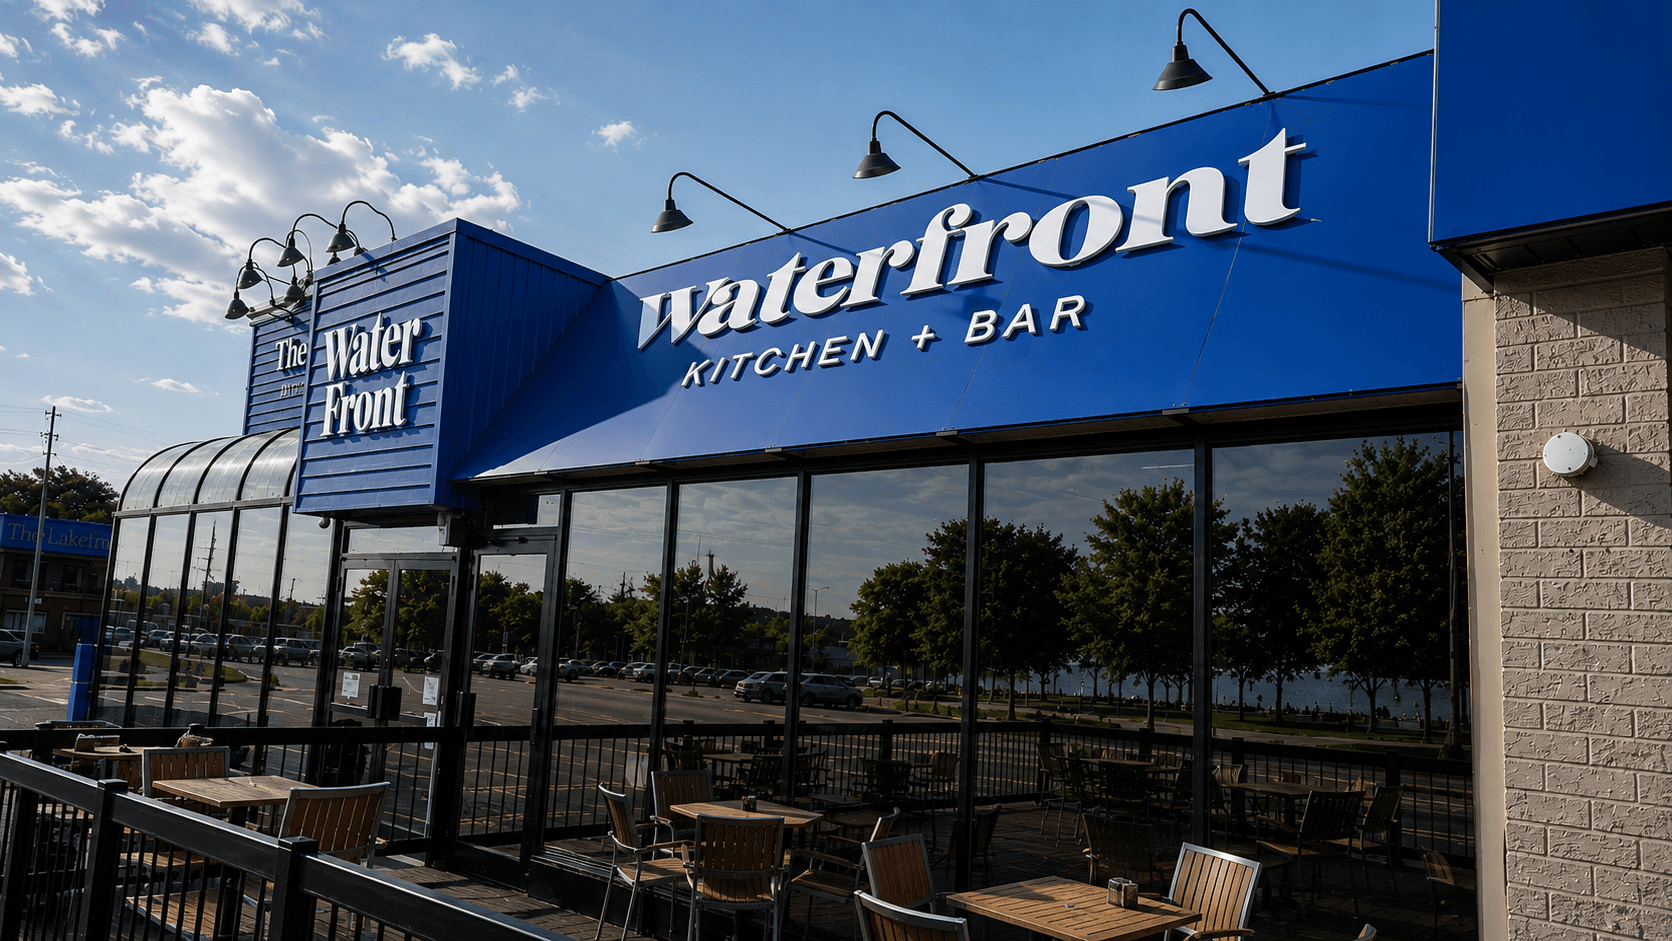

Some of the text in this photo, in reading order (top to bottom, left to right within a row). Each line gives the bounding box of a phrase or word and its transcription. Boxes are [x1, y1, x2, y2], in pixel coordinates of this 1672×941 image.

[638, 128, 1307, 350] Waterfront
[275, 337, 308, 372] The
[324, 312, 422, 381] Water
[680, 328, 885, 388] KITCHEN
[964, 294, 1086, 345] BAR
[320, 370, 409, 437] Front
